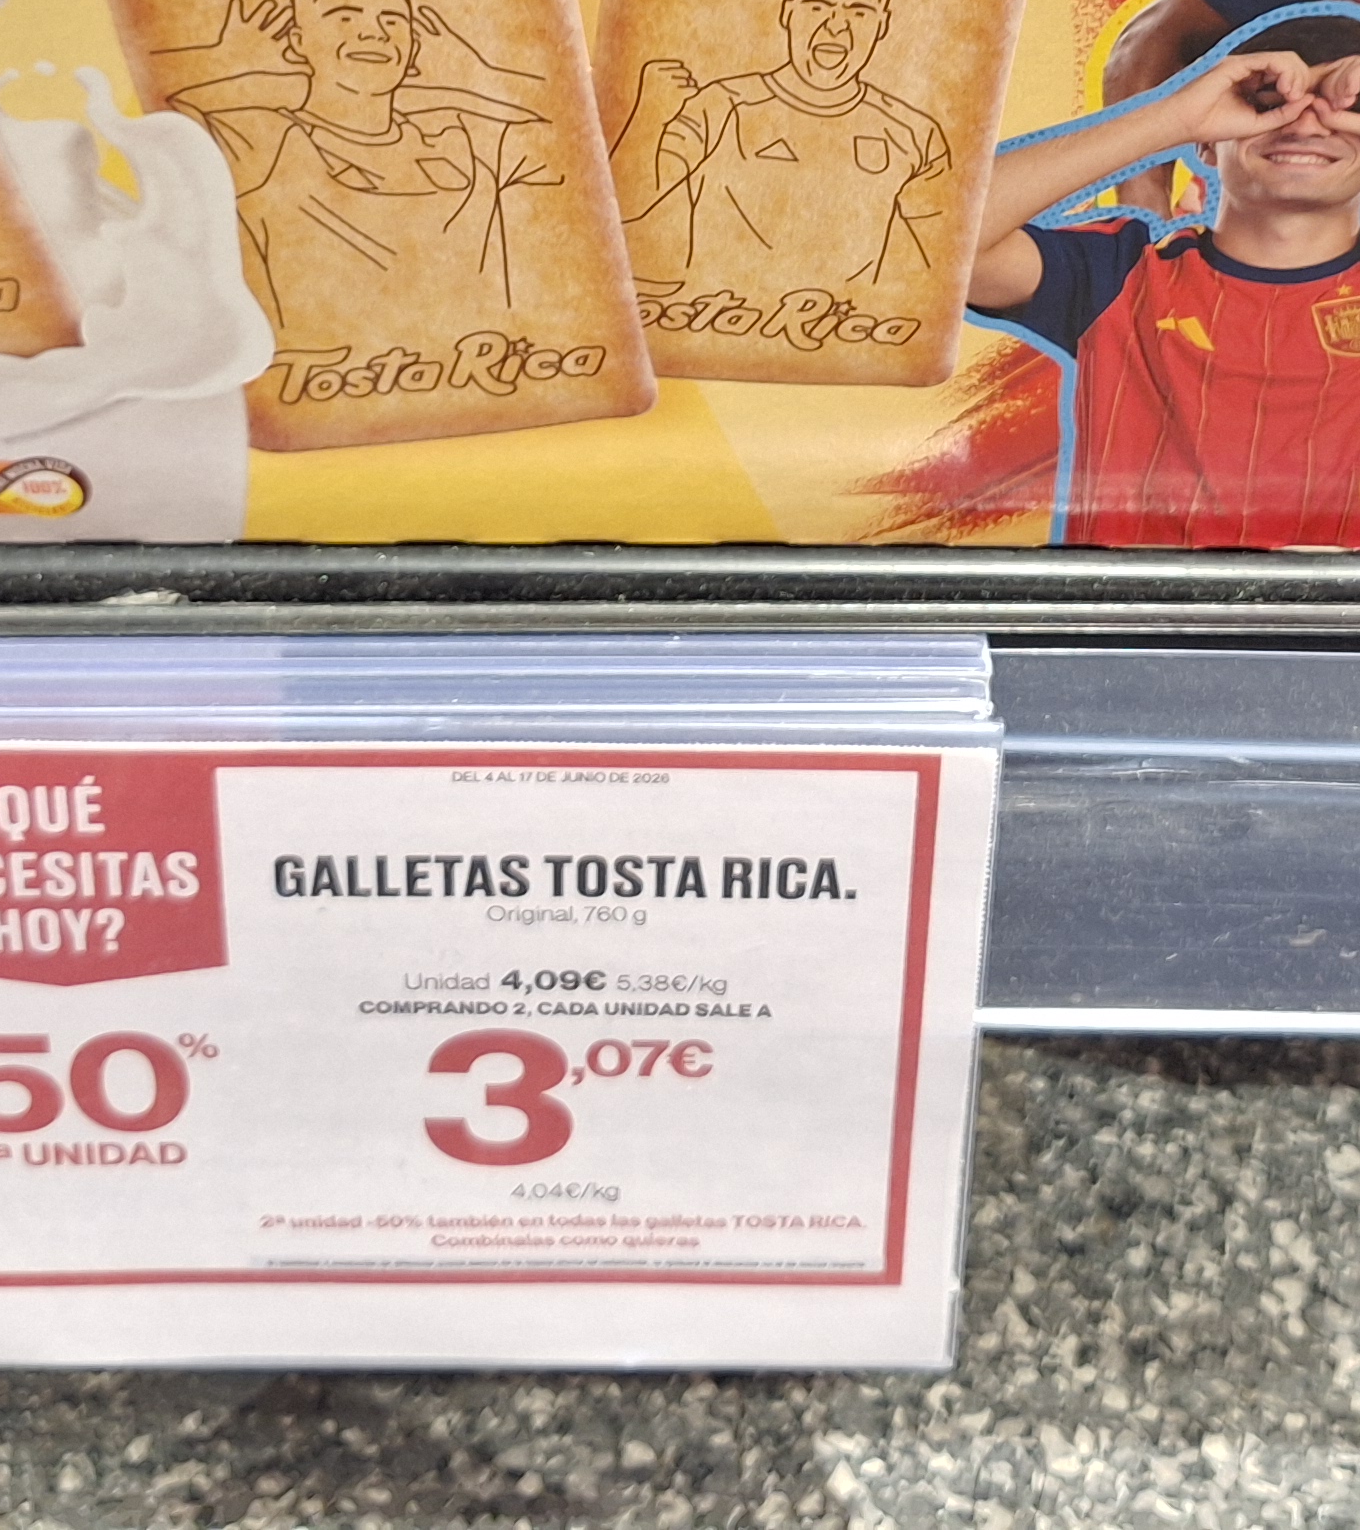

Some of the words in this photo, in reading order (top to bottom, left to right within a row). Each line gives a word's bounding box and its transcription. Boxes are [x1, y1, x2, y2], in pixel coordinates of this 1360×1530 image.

[759, 287, 922, 352] Rica
[264, 342, 443, 407] Tosta
[446, 328, 608, 396] Rica
[451, 771, 482, 783] DEL
[485, 772, 494, 782] 4
[496, 772, 516, 783] AL
[519, 772, 532, 783] 17
[535, 772, 557, 784] DE
[560, 772, 607, 784] JUNIO
[609, 772, 629, 784] DE
[632, 772, 671, 785] 2026
[273, 854, 531, 898] GALLETAS
[543, 854, 708, 899] TOSTA
[720, 855, 858, 900] RICA.
[486, 904, 579, 924] Original,
[583, 905, 629, 923] 760
[633, 908, 648, 926] g
[404, 972, 491, 991] Unidad
[500, 969, 607, 996] 4,09€
[616, 973, 728, 995] 5,38€/kg
[358, 1000, 509, 1017] COMPRANDO
[512, 1001, 533, 1019] 2,
[537, 1001, 599, 1017] CADA
[604, 1002, 690, 1018] UNIDAD
[694, 1002, 752, 1019] SALE
[755, 1003, 773, 1019] A
[21, 1141, 189, 1166] UNIDAD
[510, 1181, 622, 1202] 4,04€/kg
[291, 1213, 363, 1228] unidad
[428, 1213, 514, 1228] también
[518, 1216, 544, 1228] en
[548, 1213, 607, 1228] todas
[610, 1213, 641, 1228] las
[644, 1213, 727, 1231] galletas
[732, 1213, 805, 1229] TOSTA
[560, 1234, 619, 1247] como
[622, 1233, 701, 1248] quieras
